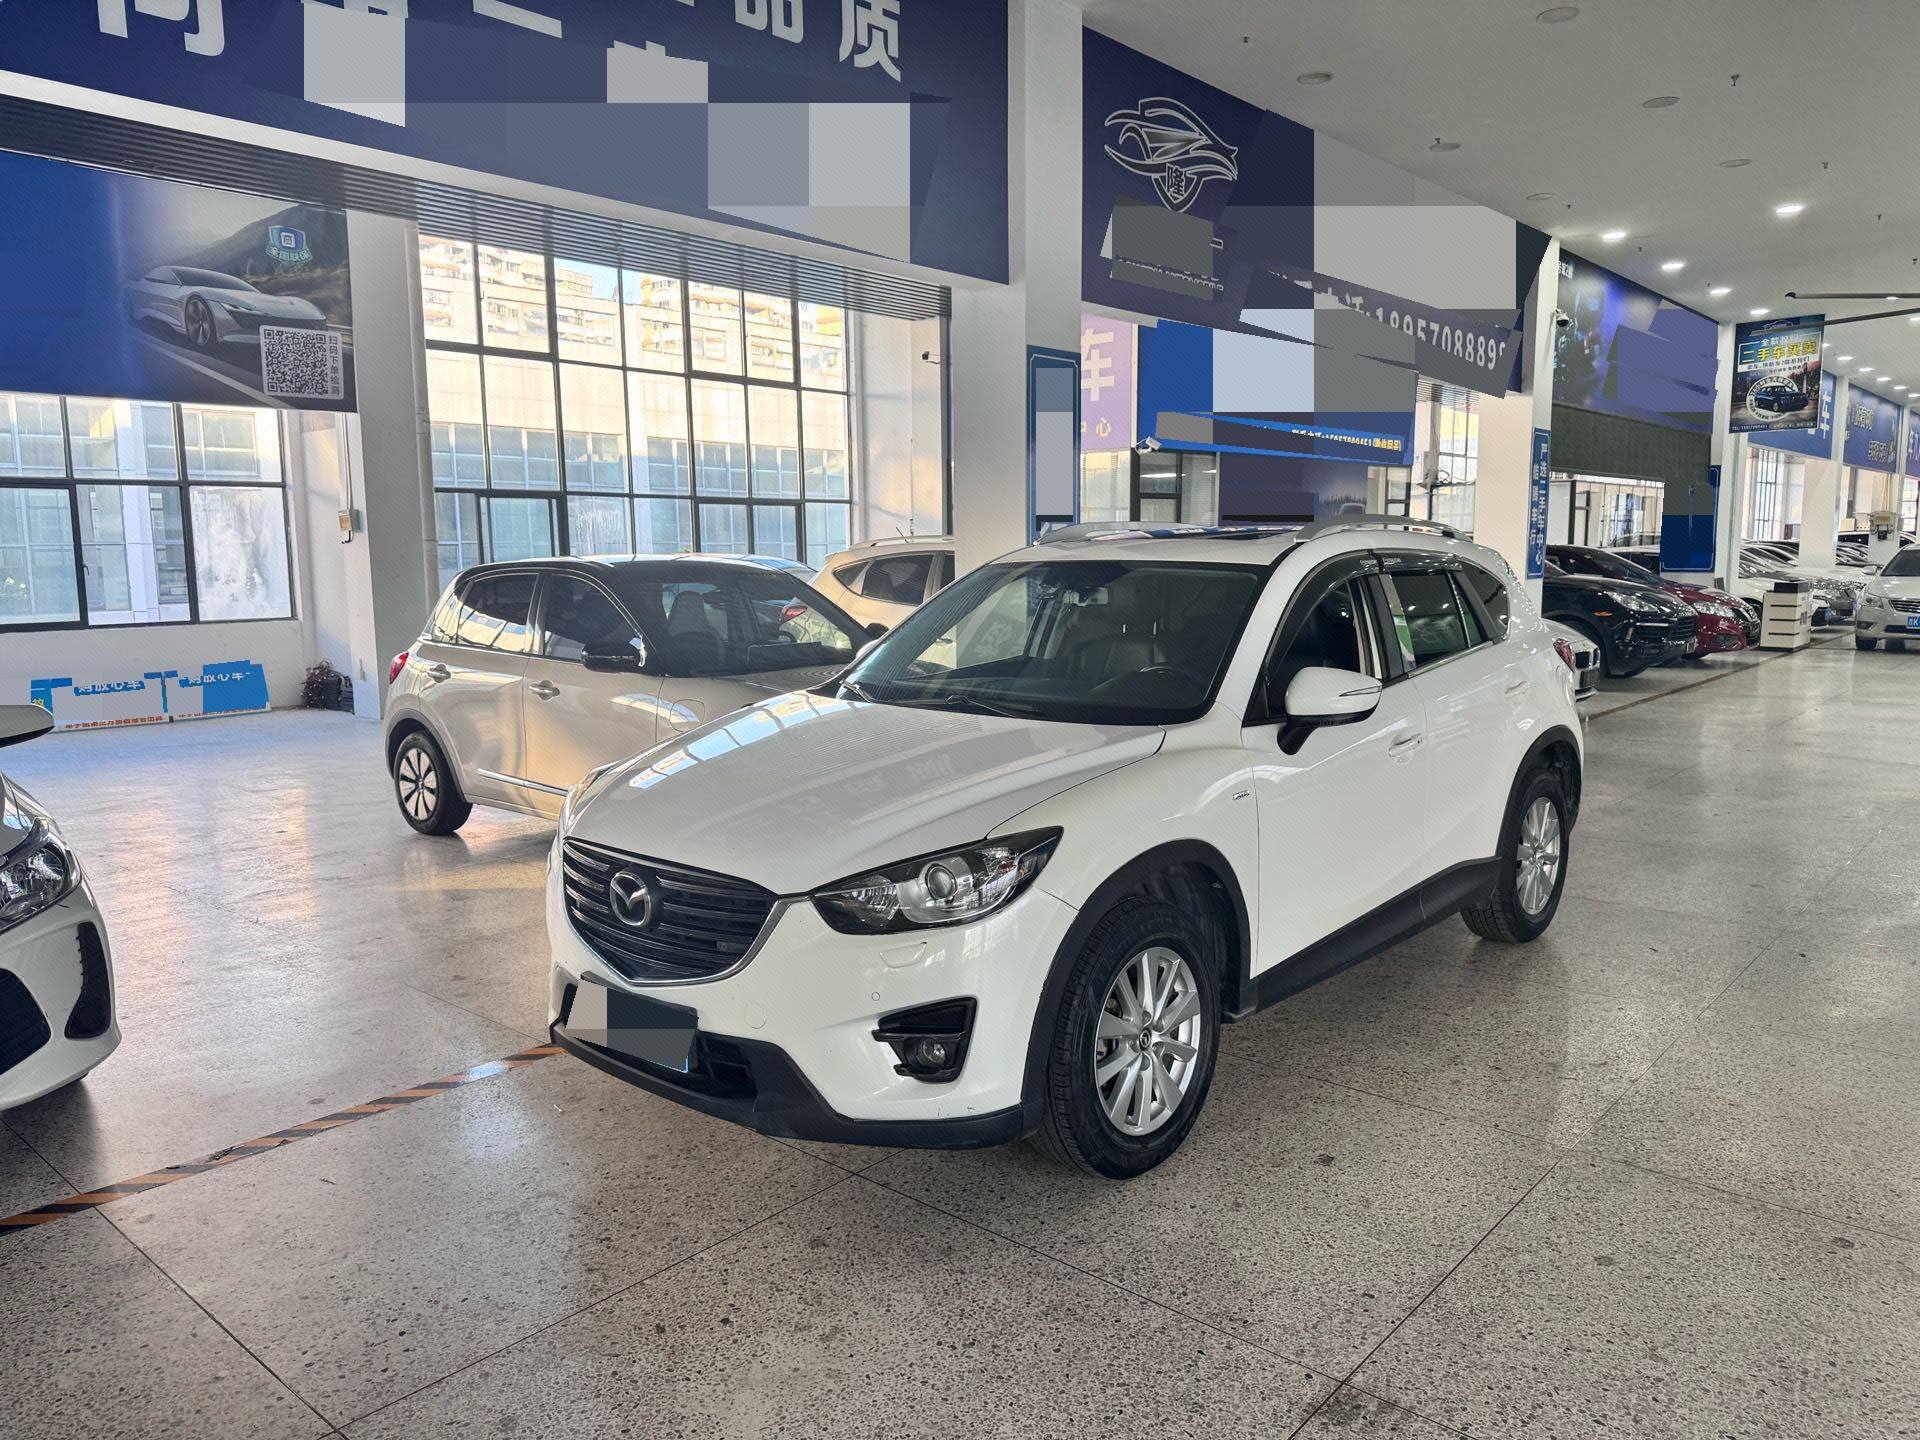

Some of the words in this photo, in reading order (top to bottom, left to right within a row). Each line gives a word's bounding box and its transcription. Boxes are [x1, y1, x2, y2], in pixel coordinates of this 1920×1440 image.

[1740, 339, 1818, 363] 二手车买卖
